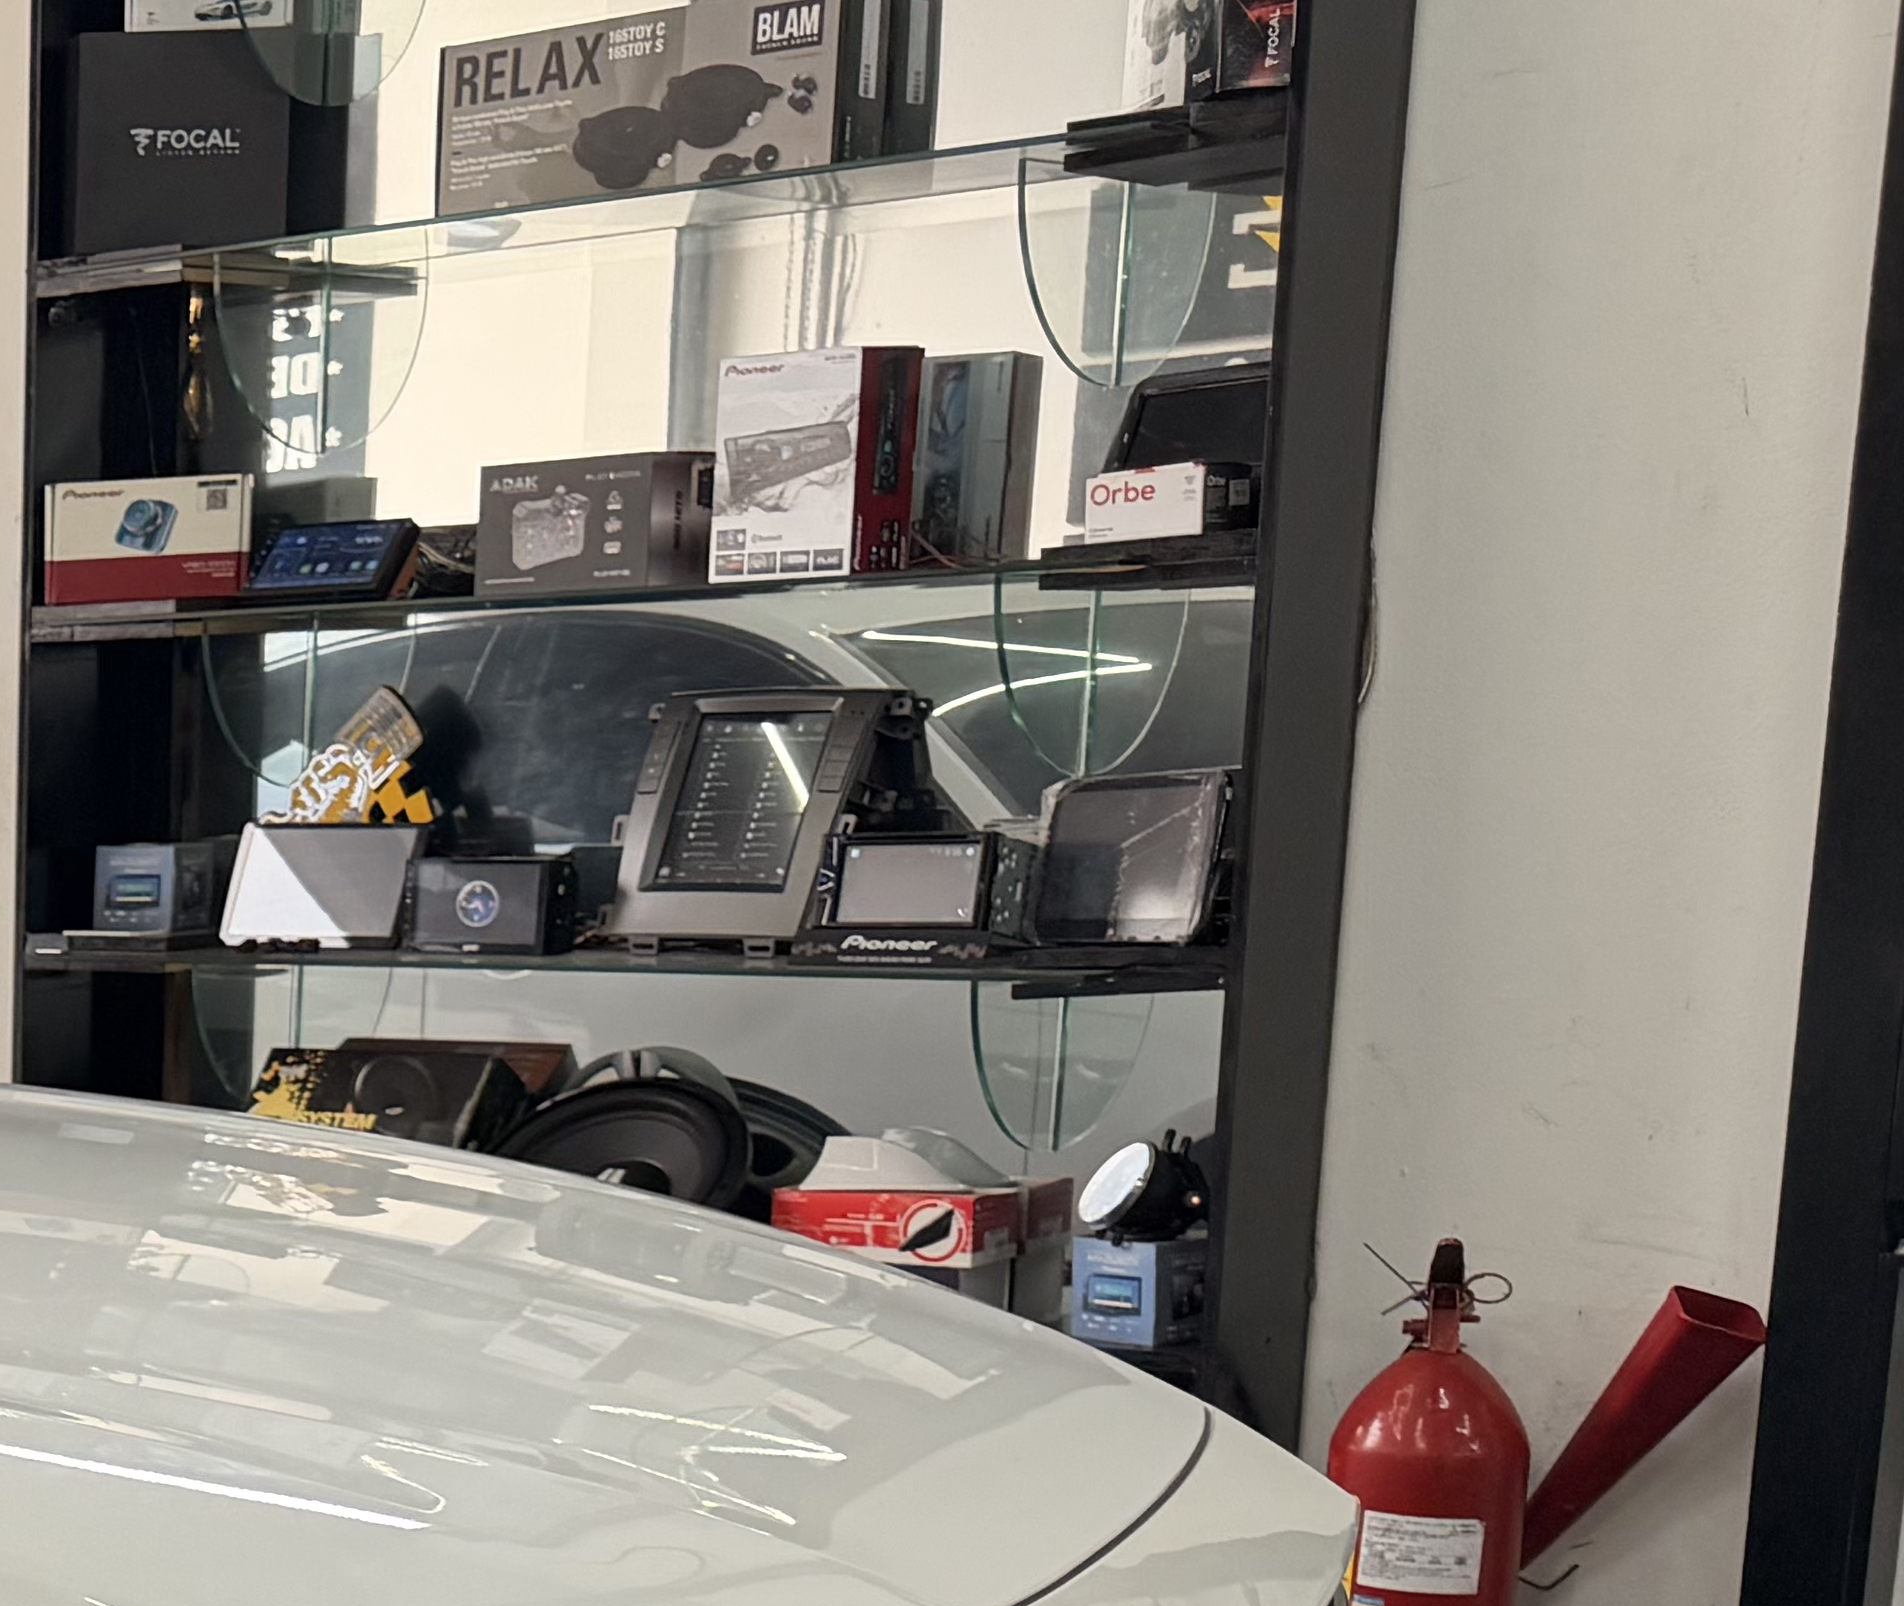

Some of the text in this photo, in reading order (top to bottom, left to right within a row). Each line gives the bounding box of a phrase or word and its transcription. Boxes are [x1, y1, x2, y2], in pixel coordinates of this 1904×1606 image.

[608, 21, 666, 43] 165TOY C
[756, 4, 821, 43] BLAM
[608, 38, 664, 60] 165TOY S
[453, 33, 604, 108] RELAX
[156, 128, 241, 149] FOCAL
[724, 364, 785, 377] Pioneer
[62, 489, 125, 501] Pioneer
[1090, 481, 1156, 506] Orbe
[841, 934, 938, 951] Pioneer
[299, 1110, 378, 1131] SYSTEM
